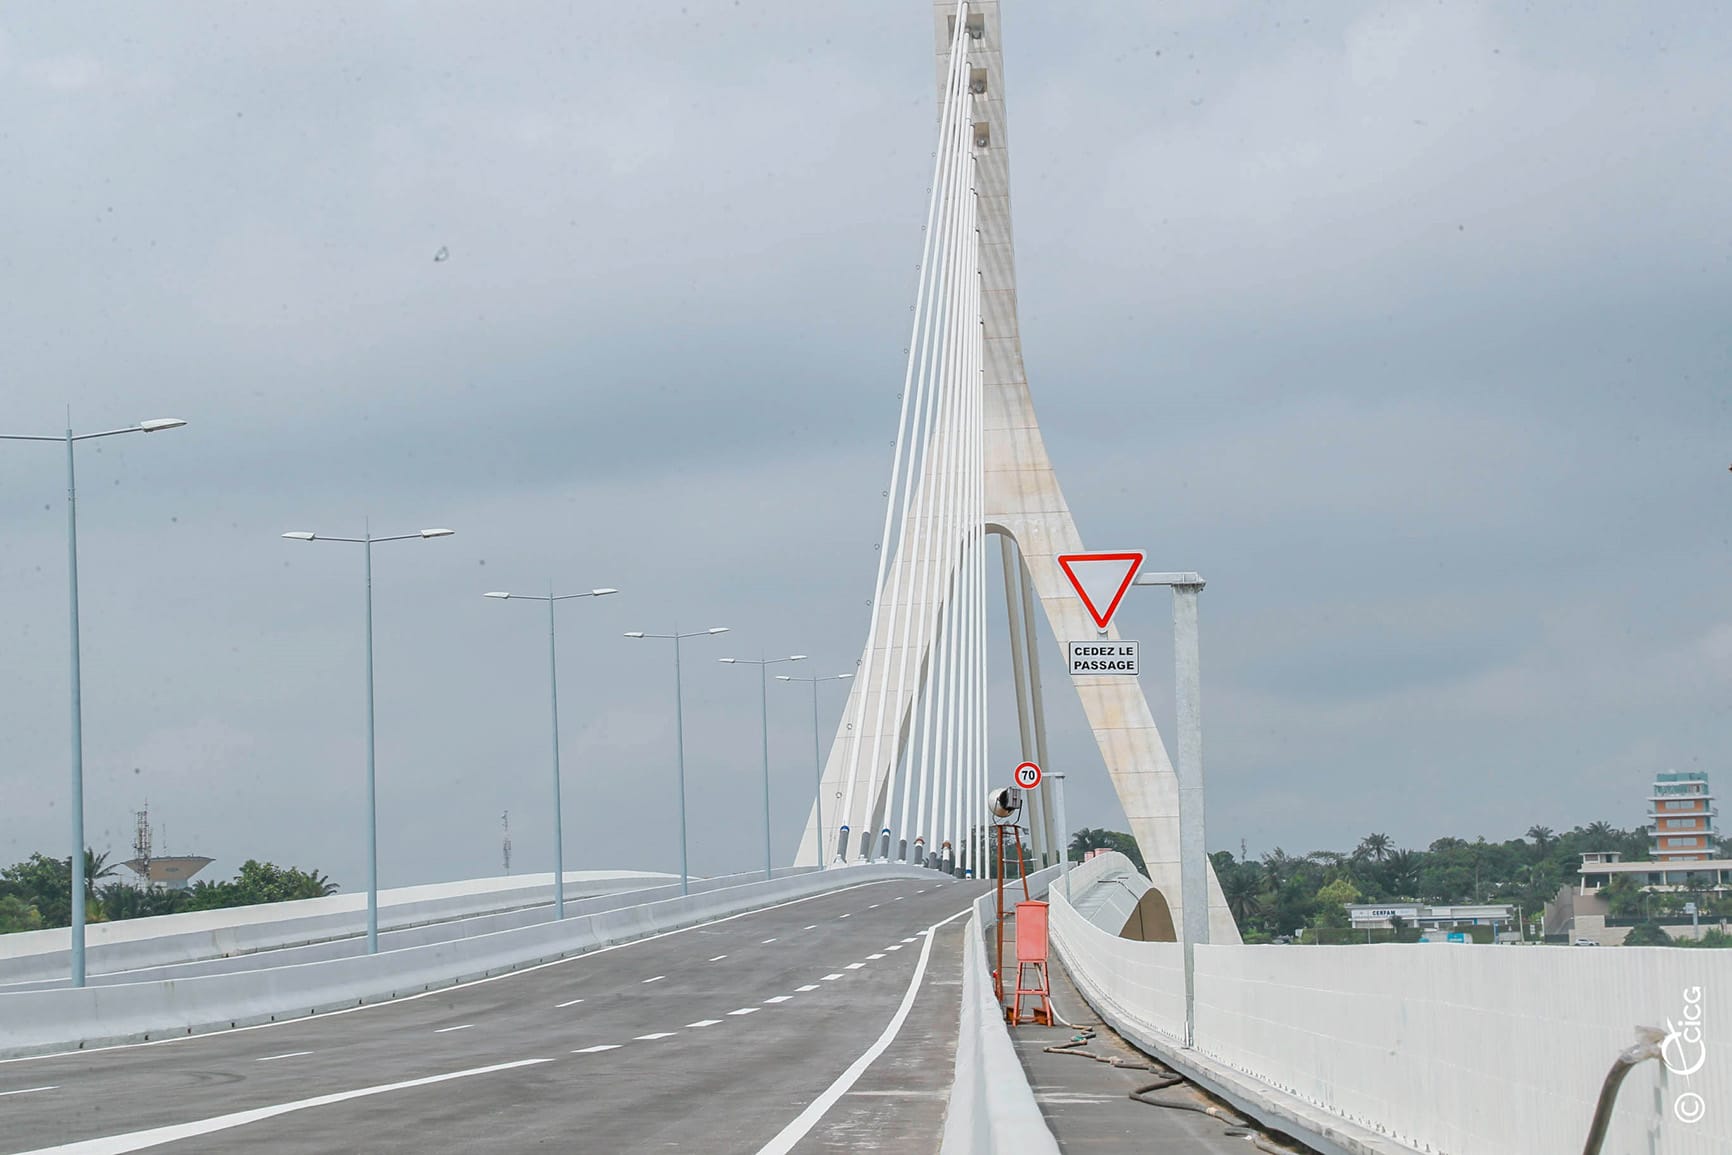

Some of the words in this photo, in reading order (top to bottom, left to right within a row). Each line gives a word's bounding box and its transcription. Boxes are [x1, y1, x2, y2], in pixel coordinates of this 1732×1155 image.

[1074, 647, 1115, 656] CEDEZ
[1119, 647, 1134, 656] LE
[1074, 661, 1135, 670] PASSAGE
[1021, 770, 1035, 780] 70
